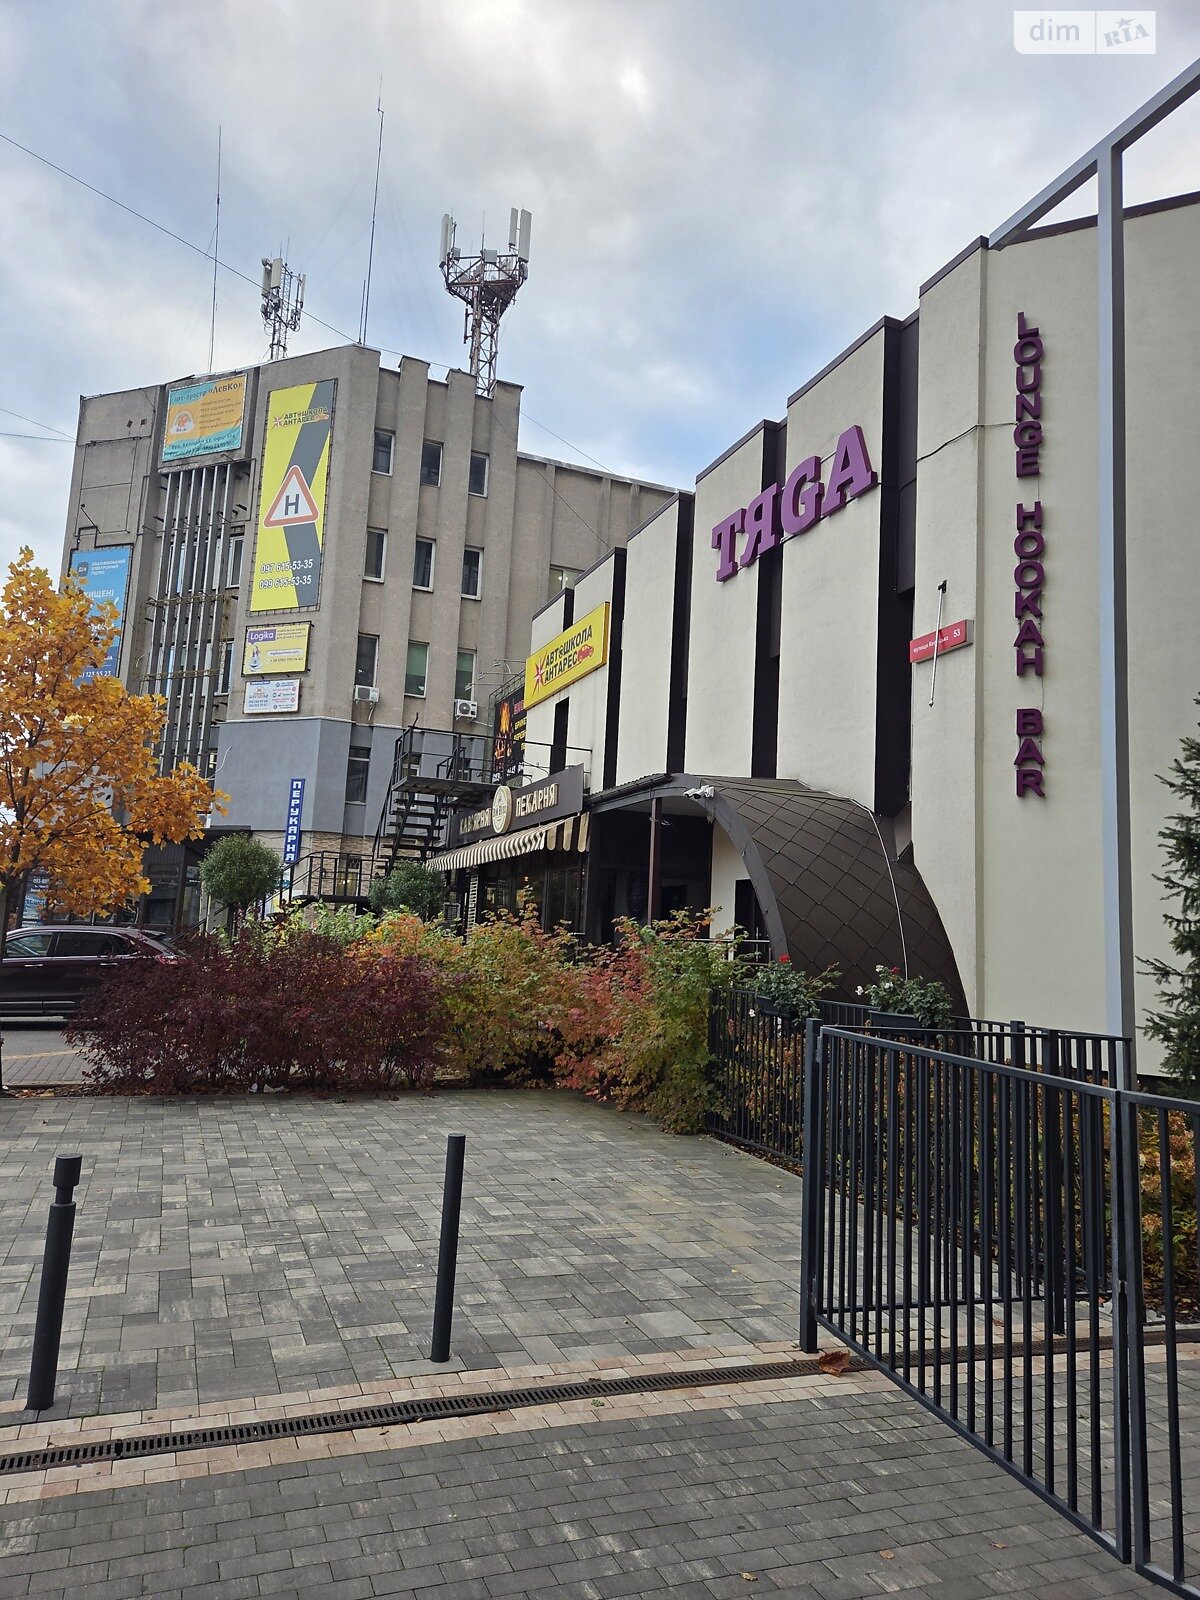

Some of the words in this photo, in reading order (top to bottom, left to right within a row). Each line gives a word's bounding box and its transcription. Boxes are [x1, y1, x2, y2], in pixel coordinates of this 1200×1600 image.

[1013, 311, 1044, 477] LOUNGE
[261, 562, 275, 573] 097
[276, 558, 313, 572] 615-53-35
[259, 579, 273, 590] 099
[274, 575, 312, 589] 615-53-35
[1013, 500, 1045, 677] HOOKAH
[250, 631, 274, 641] Logika
[953, 628, 961, 638] 53
[544, 652, 578, 684] АНТАРЕС
[1013, 708, 1045, 797] BAR
[515, 783, 559, 818] ПЕКАРНЯ
[285, 781, 302, 861] ПЕРУКАРНЯ
